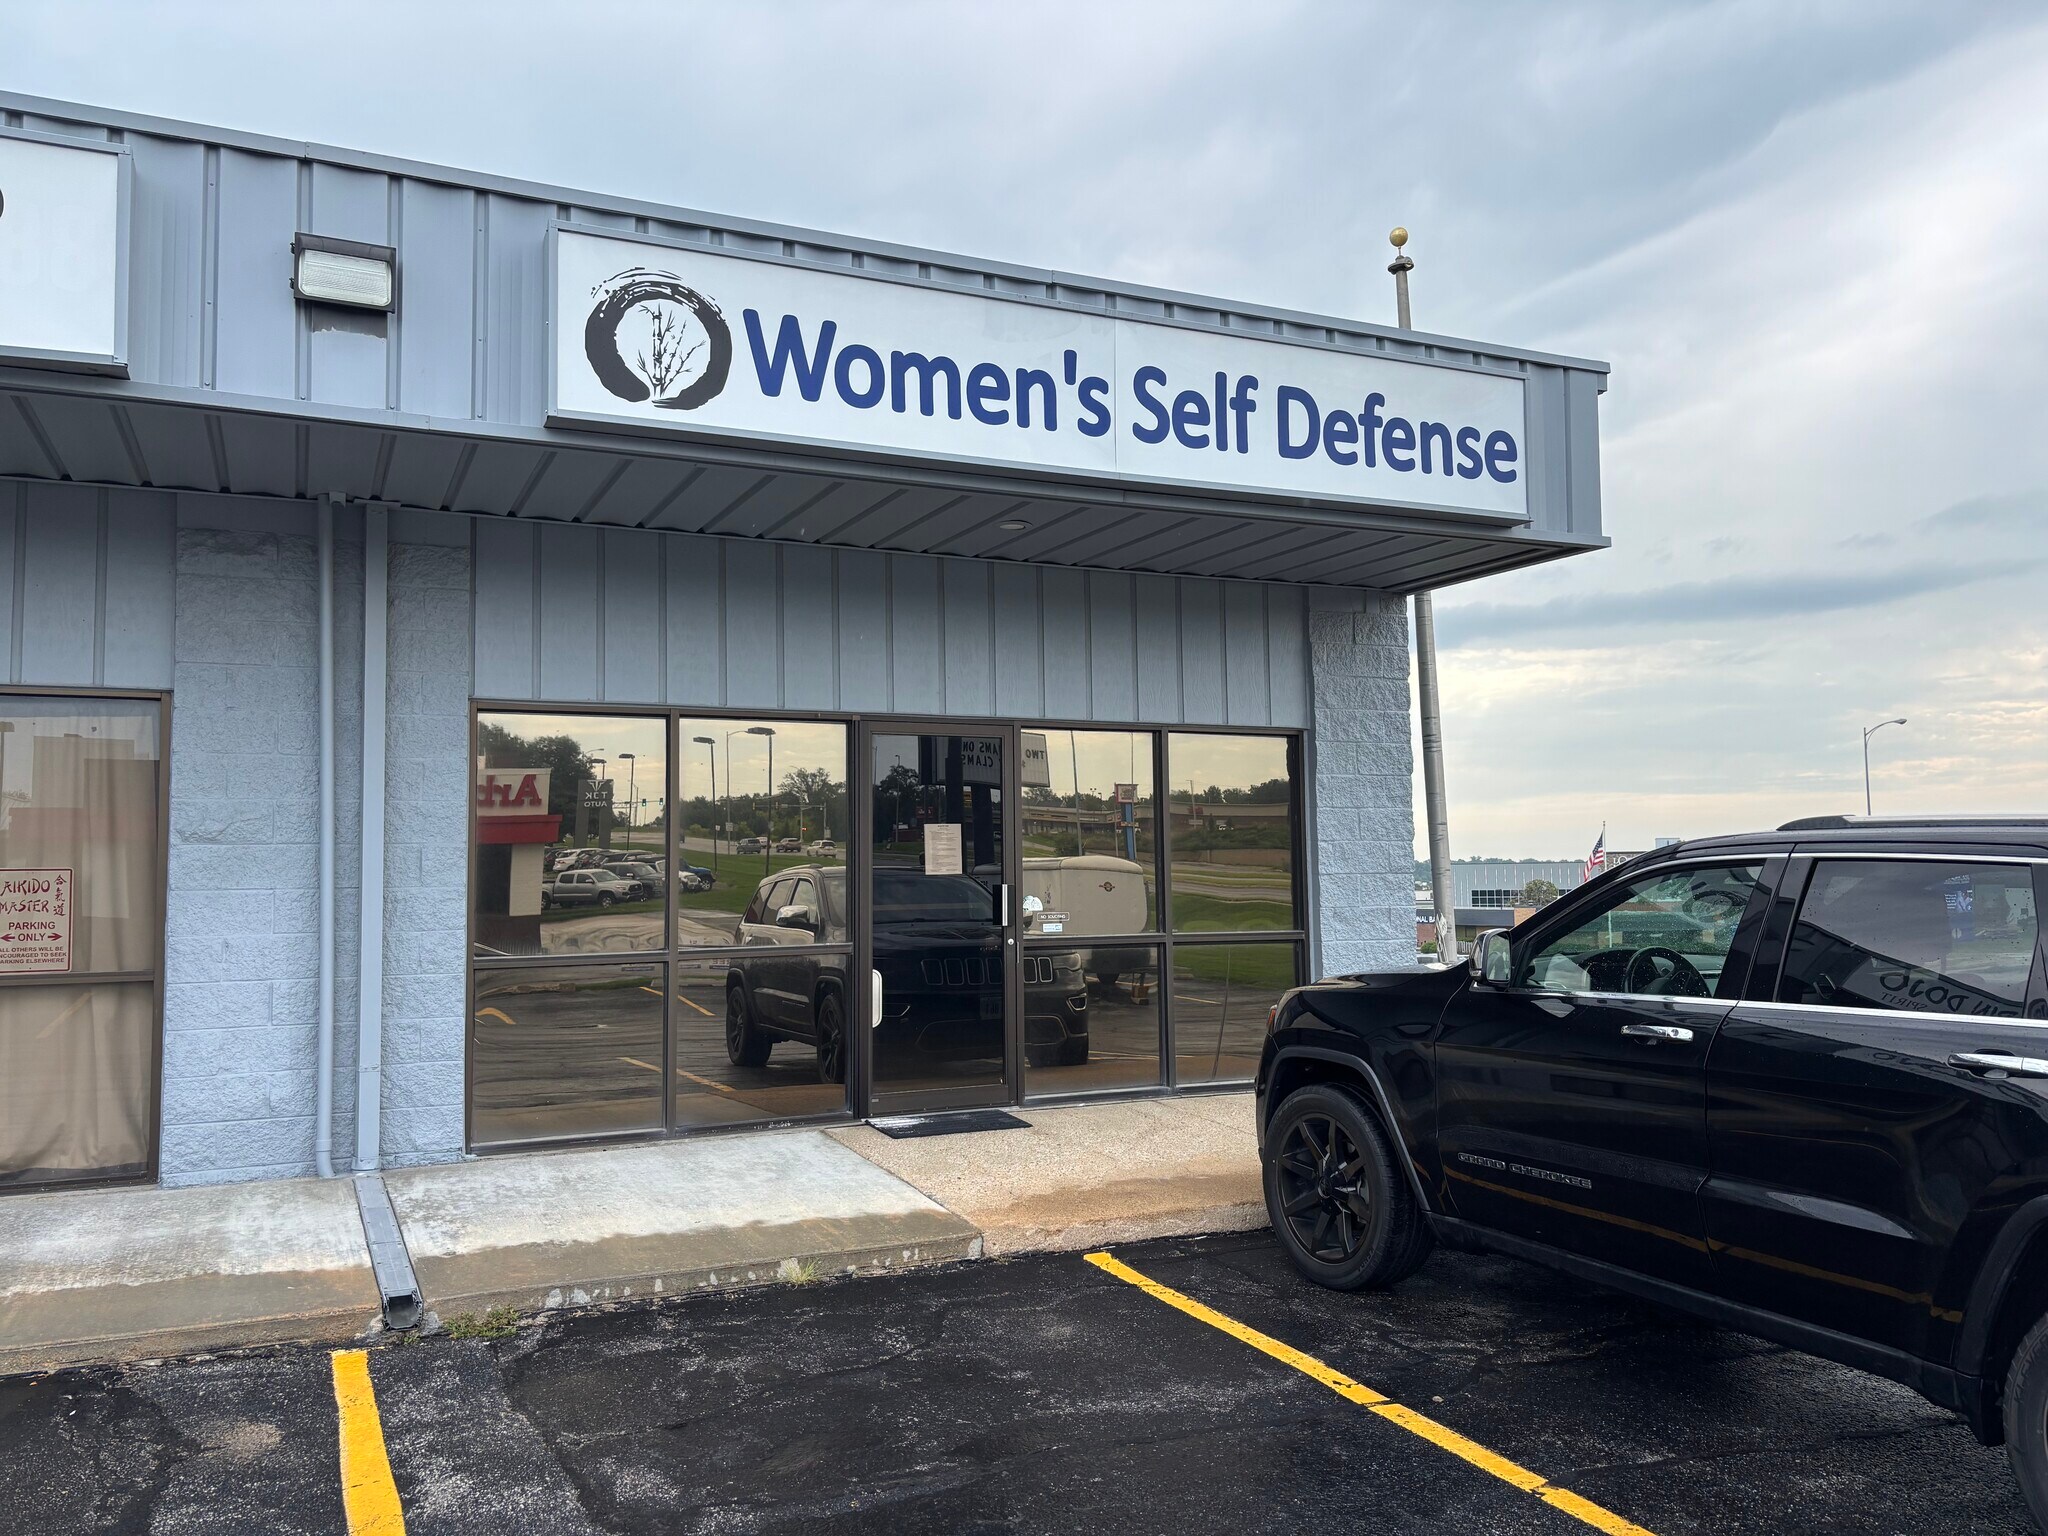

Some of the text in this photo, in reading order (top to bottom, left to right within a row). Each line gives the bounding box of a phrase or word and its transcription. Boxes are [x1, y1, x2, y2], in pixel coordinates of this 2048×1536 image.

[743, 309, 1516, 483] Women's Self Defense
[0, 878, 50, 896] AIKIDO
[0, 899, 49, 914] MASTER
[8, 921, 56, 930] PARKING
[18, 932, 46, 942] ONLY
[1458, 1152, 1592, 1189] GRAND CHEROKEE
